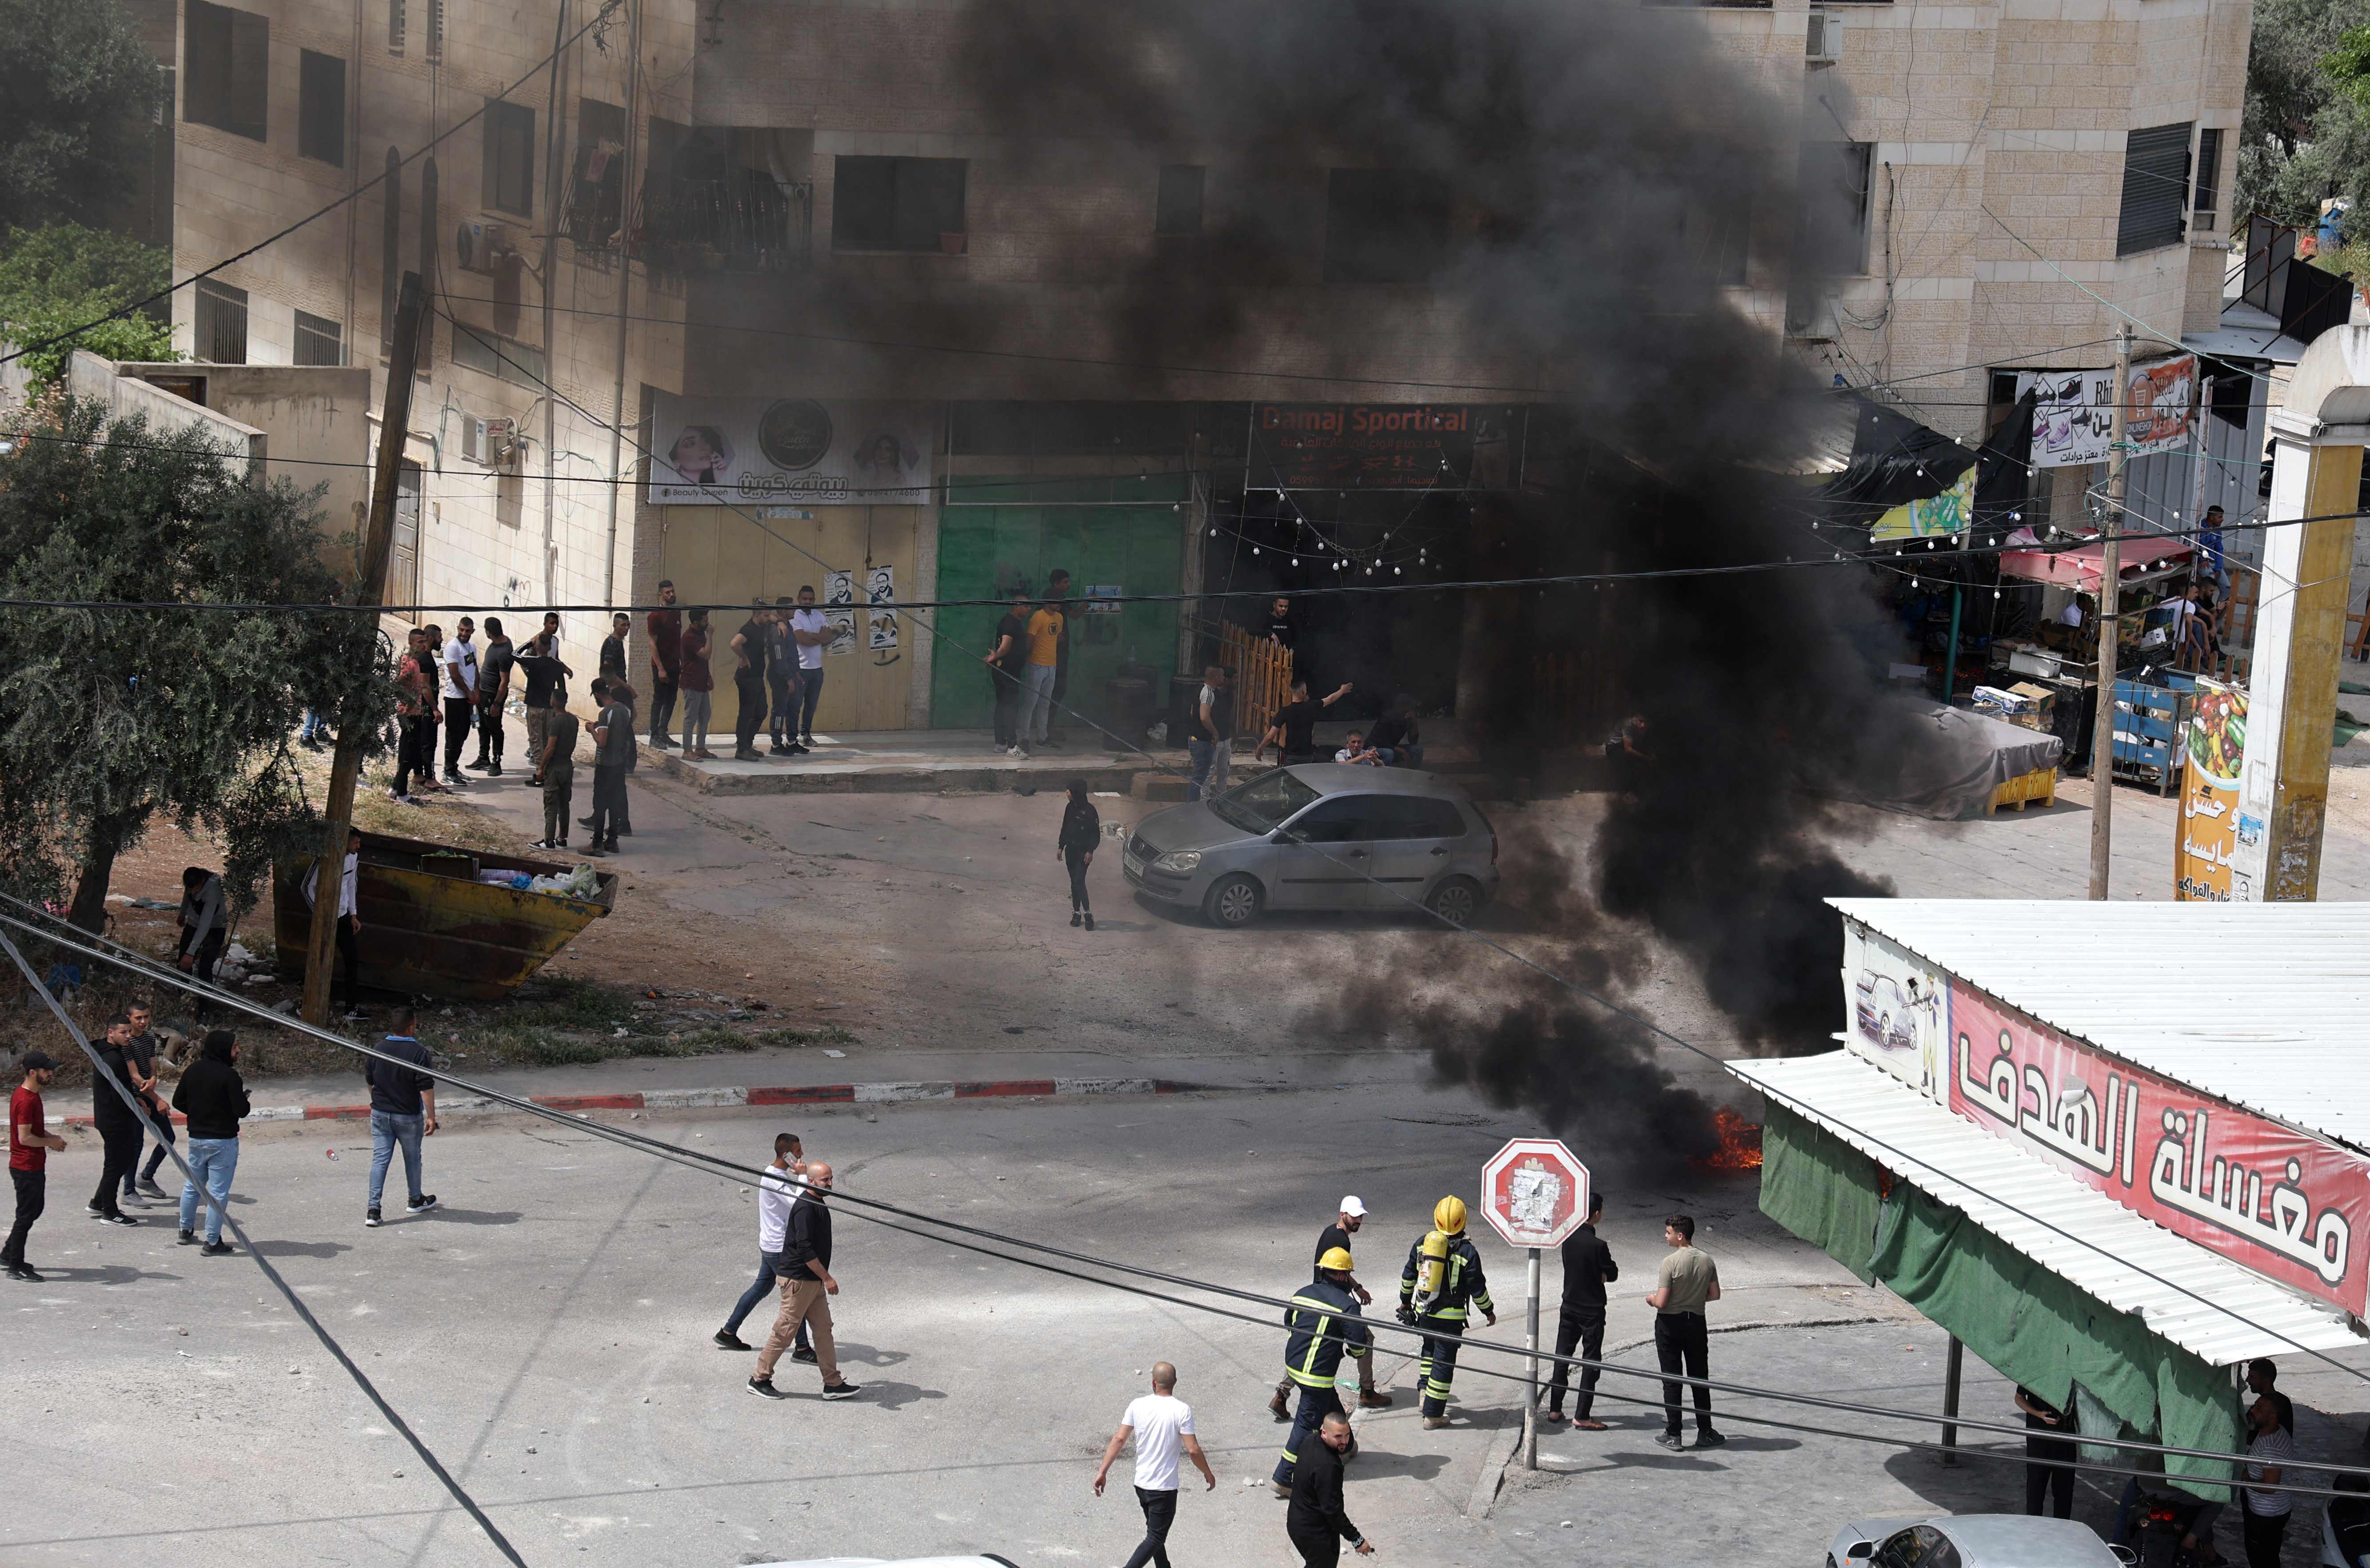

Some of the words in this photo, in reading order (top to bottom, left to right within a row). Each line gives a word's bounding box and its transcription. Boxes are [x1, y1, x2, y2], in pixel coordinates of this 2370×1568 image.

[2095, 378, 2114, 406] Rhi
[2155, 375, 2174, 397] SHOES
[1261, 405, 1345, 436] Damaj
[1352, 405, 1468, 435] Sportical
[2127, 420, 2152, 433] ONLINESHOP
[2060, 451, 2083, 464] جرادات
[2084, 450, 2098, 462] معتز
[673, 488, 699, 497] Beauty
[702, 488, 728, 497] Queen
[739, 472, 788, 498] كوين
[789, 473, 849, 499] بيوتي
[2185, 787, 2226, 819] حسن
[2182, 832, 2233, 874] مايسه
[1958, 1028, 2139, 1190] الهدف
[2150, 1106, 2351, 1288] مغسلة
